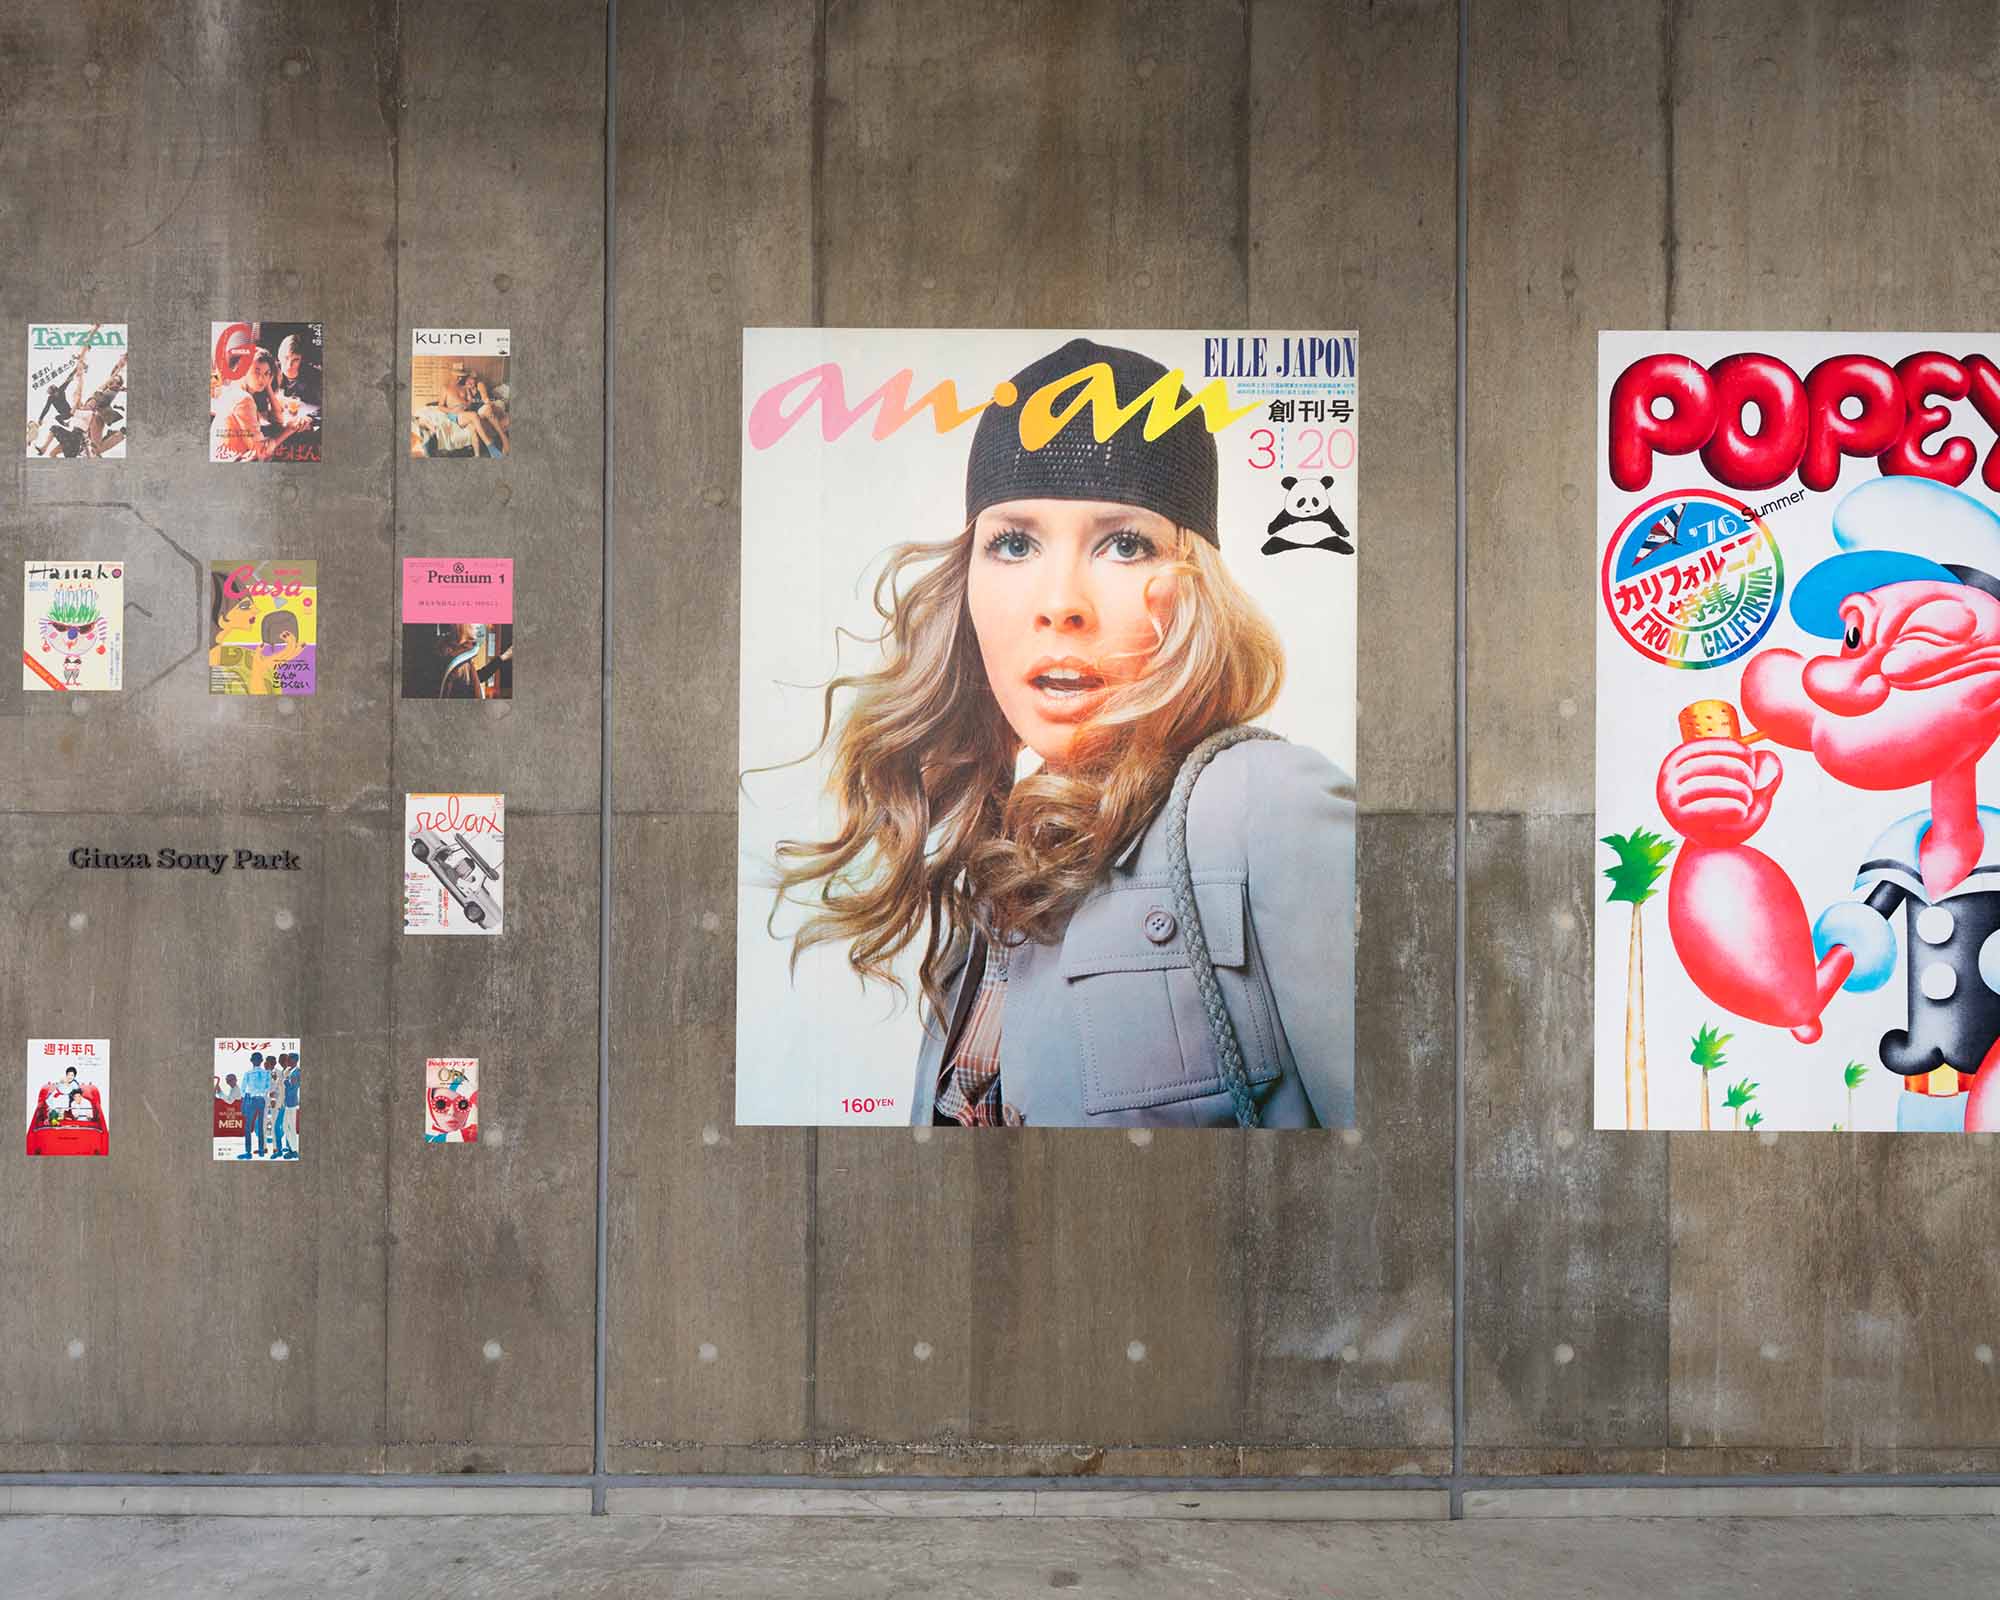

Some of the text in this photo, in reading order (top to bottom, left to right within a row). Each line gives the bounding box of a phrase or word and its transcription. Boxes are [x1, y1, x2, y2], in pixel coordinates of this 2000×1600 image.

[1204, 337, 1357, 377] ELLE JAPON
[1268, 400, 1354, 423] 創刊号
[1248, 429, 1356, 469] 3 20
[1741, 489, 1805, 523] Summer
[428, 570, 491, 584] Premium
[1614, 532, 1763, 616] カリフォルニア
[1631, 566, 1773, 658] FROM CALIFORNIA
[1667, 582, 1736, 624] 特集
[416, 795, 503, 833] relax
[69, 848, 301, 875] Ginza Sony Park
[44, 1043, 95, 1056] 週刊平凡
[218, 1120, 242, 1129] MEN
